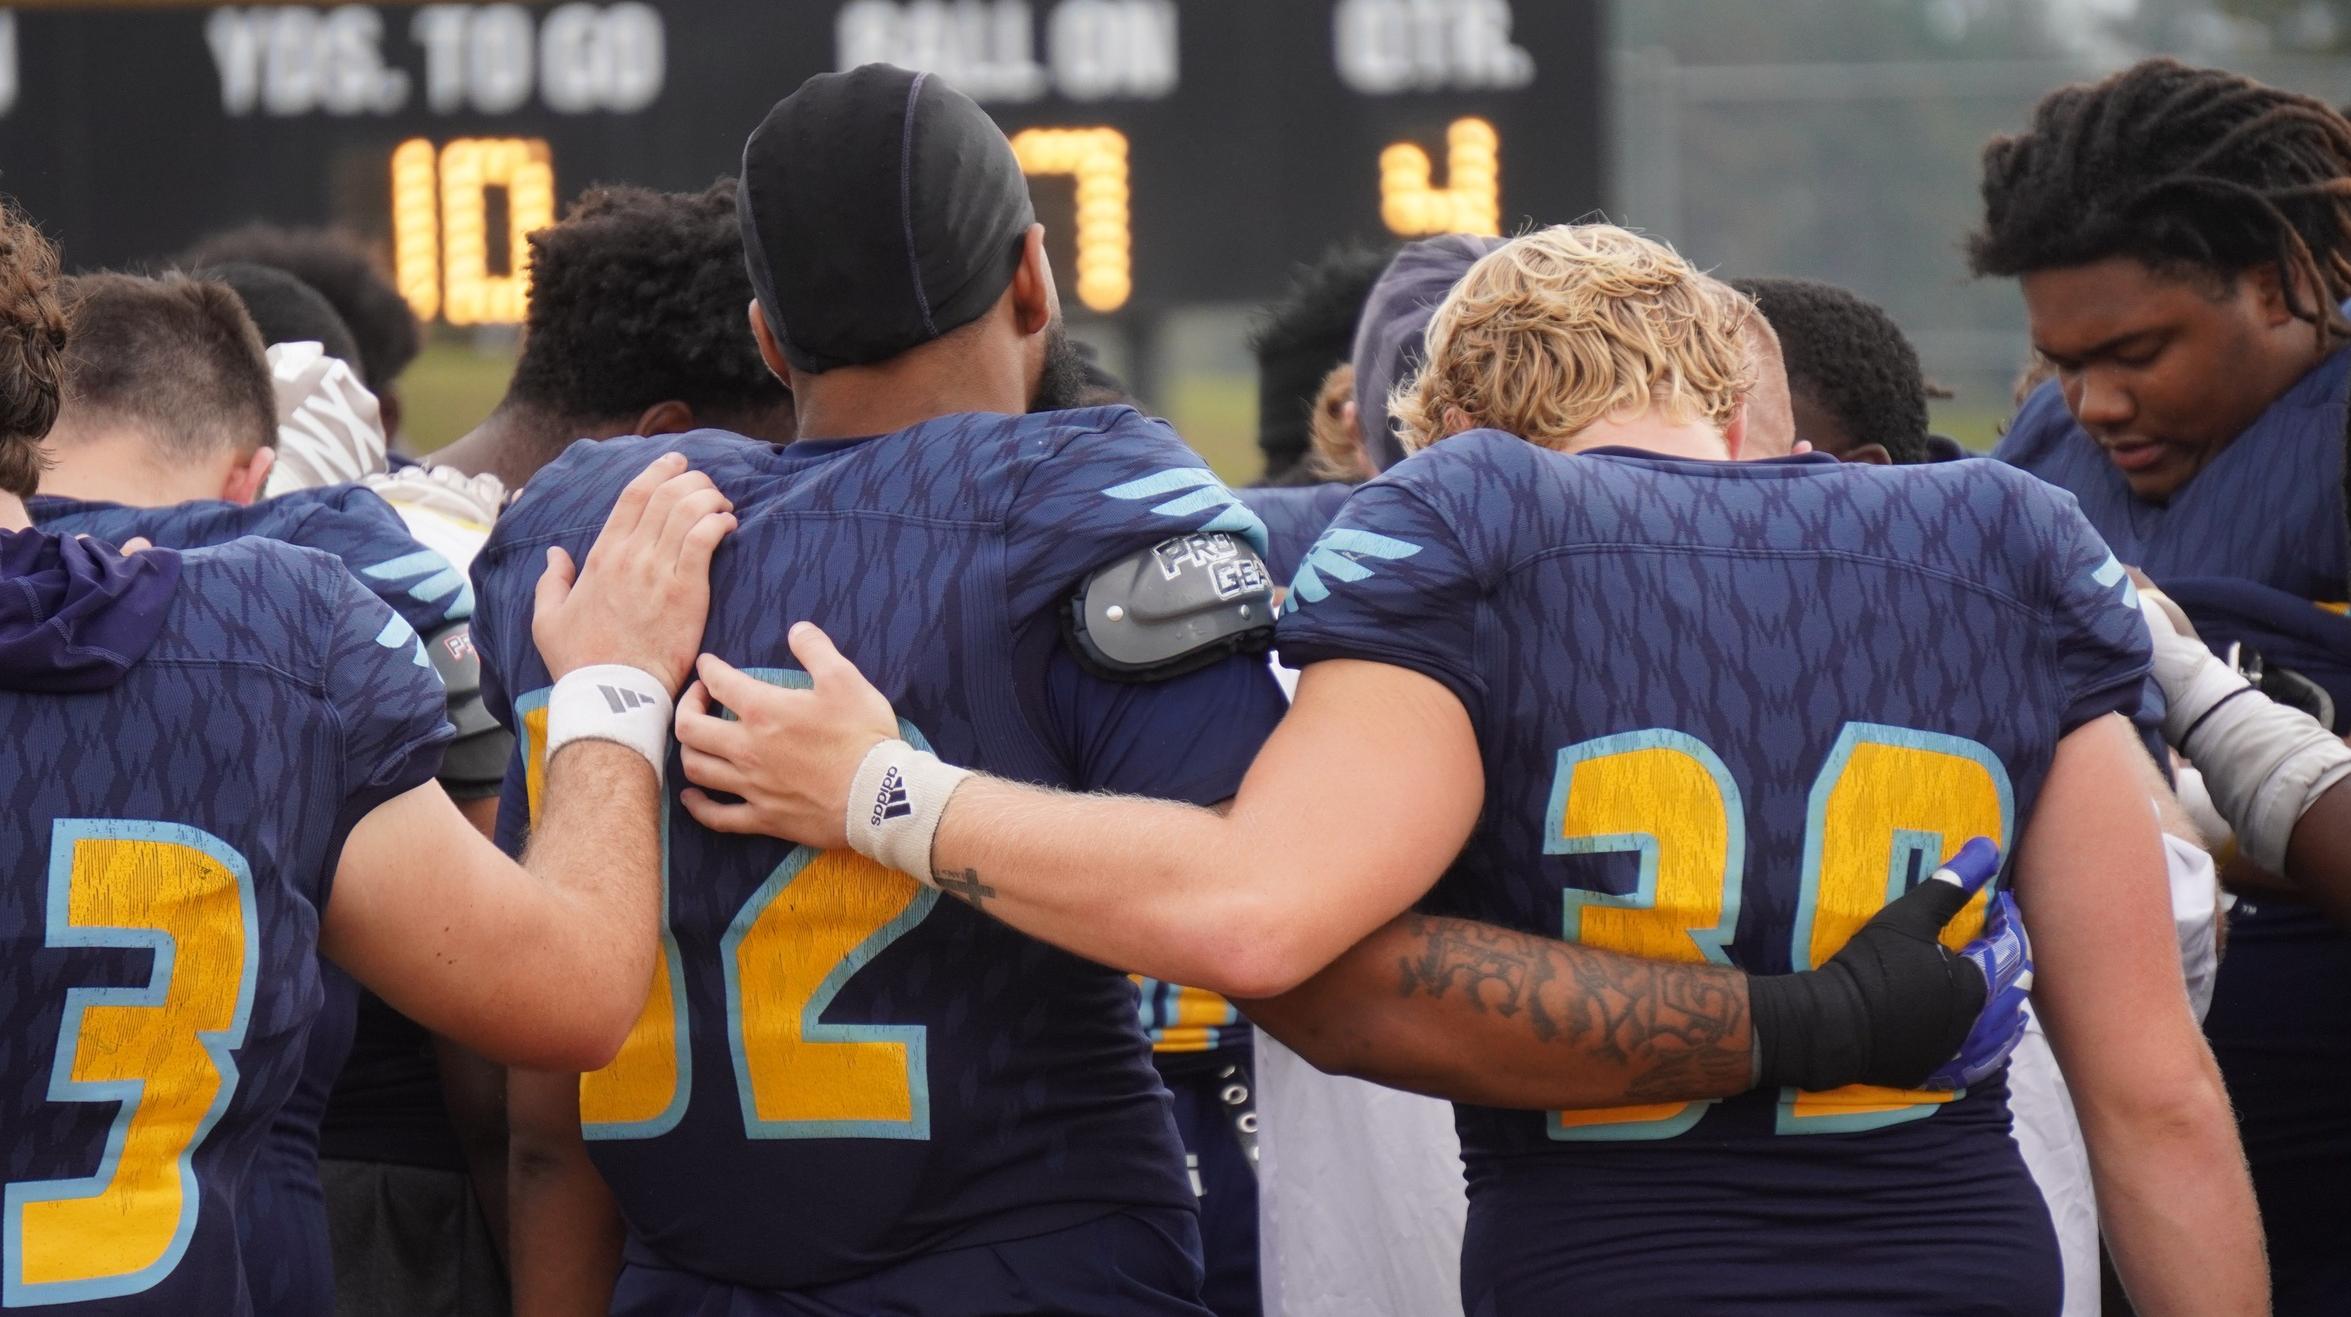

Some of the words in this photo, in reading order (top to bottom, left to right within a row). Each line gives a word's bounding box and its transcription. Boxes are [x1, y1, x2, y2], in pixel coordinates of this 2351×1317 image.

[410, 4, 534, 116] TO
[540, 2, 667, 115] GO
[392, 137, 556, 326] 10
[1012, 126, 1132, 312] 7
[1378, 115, 1501, 237] 4
[1153, 533, 1238, 580] PRO
[871, 766, 898, 826] adidas
[515, 667, 945, 1141] 2
[2, 818, 260, 1308] 3
